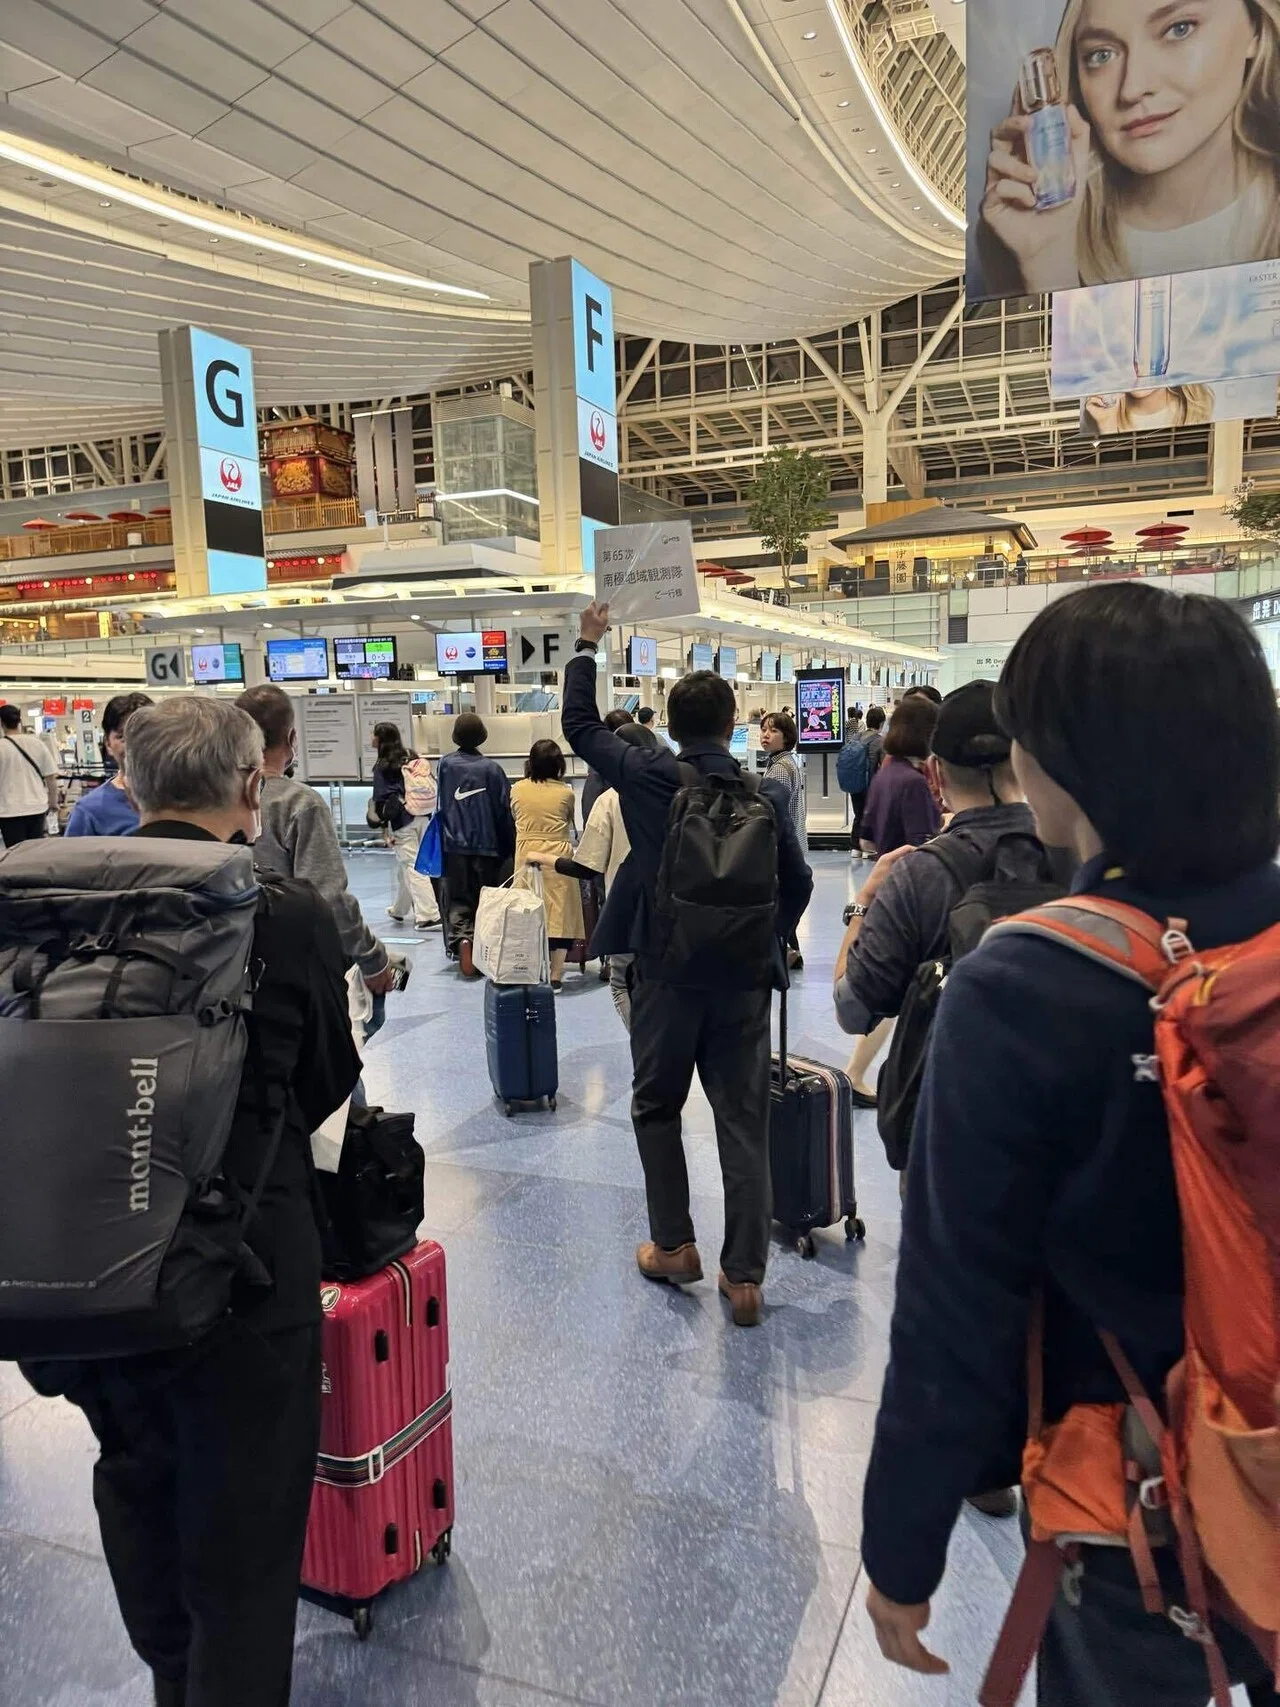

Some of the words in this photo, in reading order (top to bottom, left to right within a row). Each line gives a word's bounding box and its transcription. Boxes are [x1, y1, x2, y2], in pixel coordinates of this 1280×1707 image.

[585, 292, 603, 373] F
[205, 360, 245, 428] G
[226, 481, 239, 490] JAL
[230, 497, 254, 506] AIRLINES
[602, 548, 634, 562] 第65次
[603, 566, 684, 588] 南極地域観測隊
[1253, 600, 1270, 620] 出発
[543, 634, 559, 664] F
[151, 653, 168, 680] G
[82, 711, 90, 722] 2
